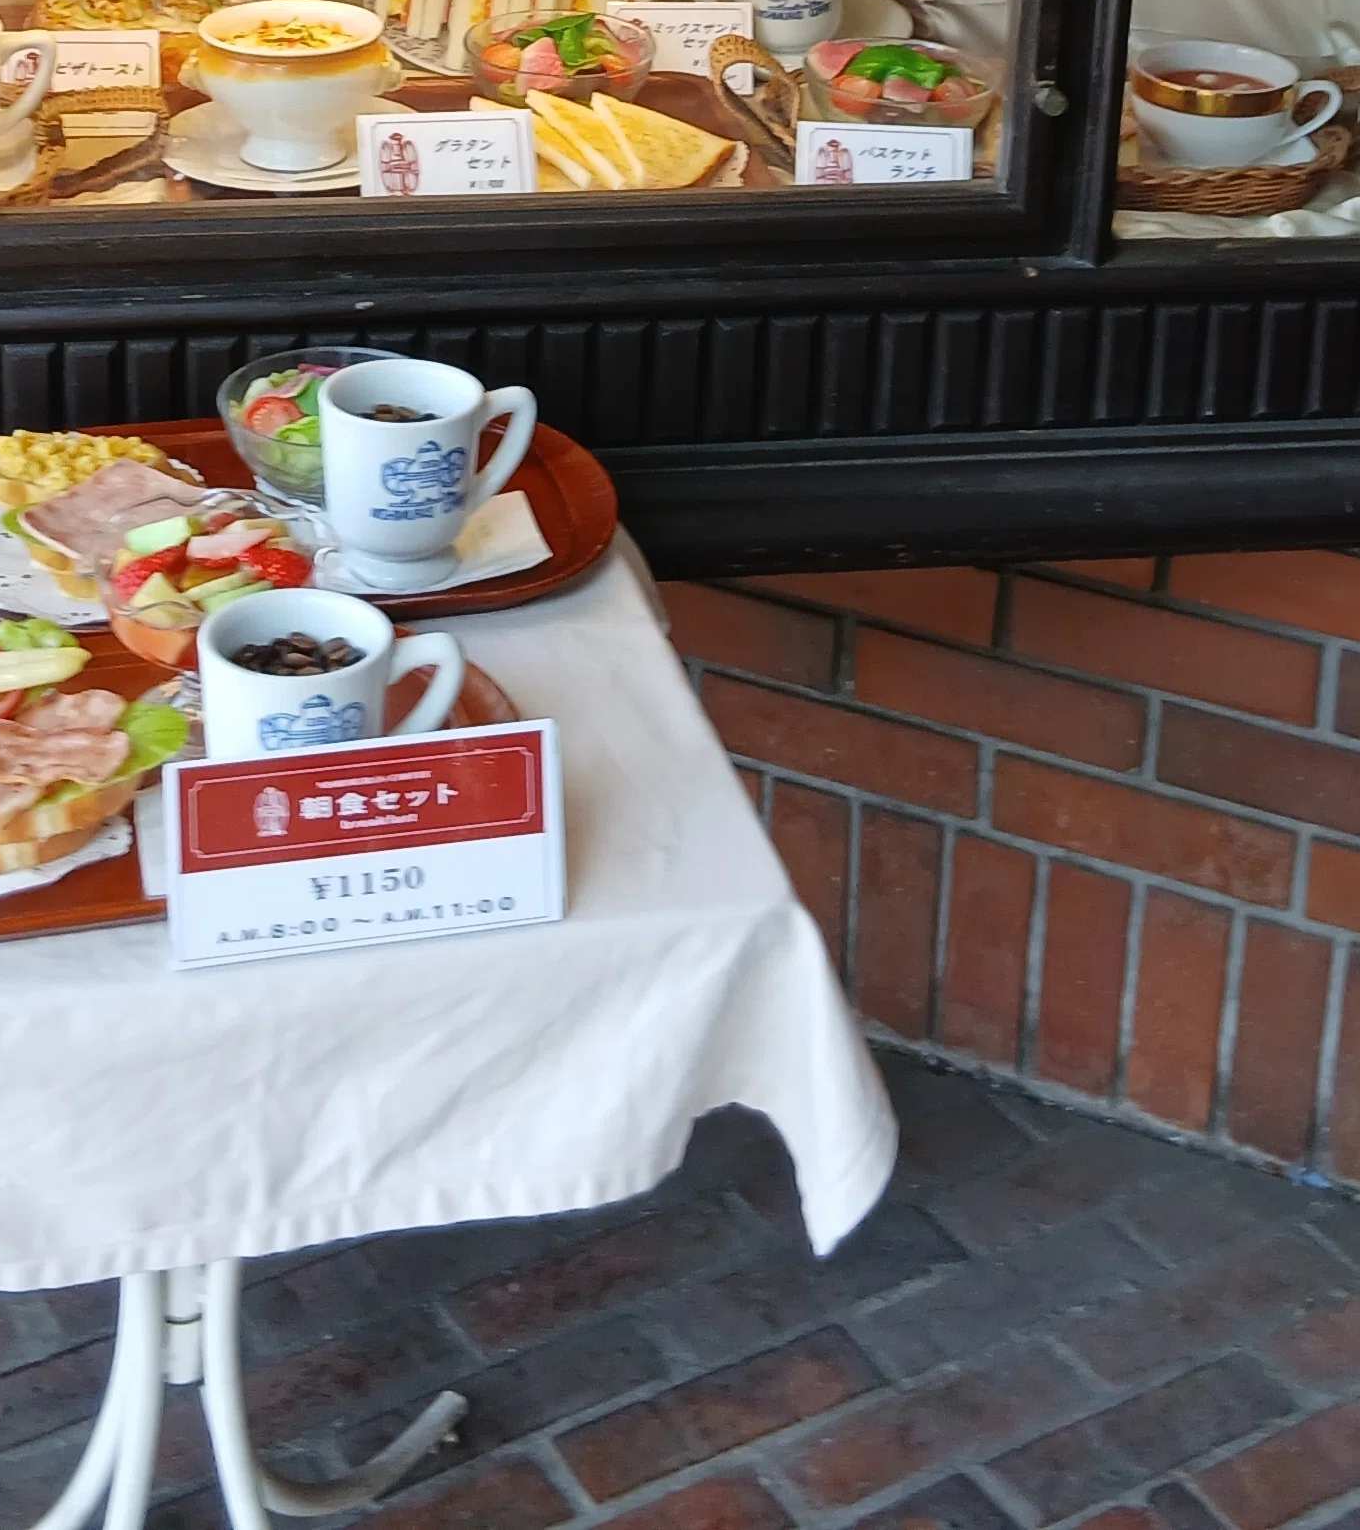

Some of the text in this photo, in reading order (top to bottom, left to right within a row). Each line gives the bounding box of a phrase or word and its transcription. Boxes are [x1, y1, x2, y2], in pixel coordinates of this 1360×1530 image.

[467, 156, 511, 169] セット
[298, 783, 459, 820] 朝食セット
[308, 865, 425, 901] ¥1150
